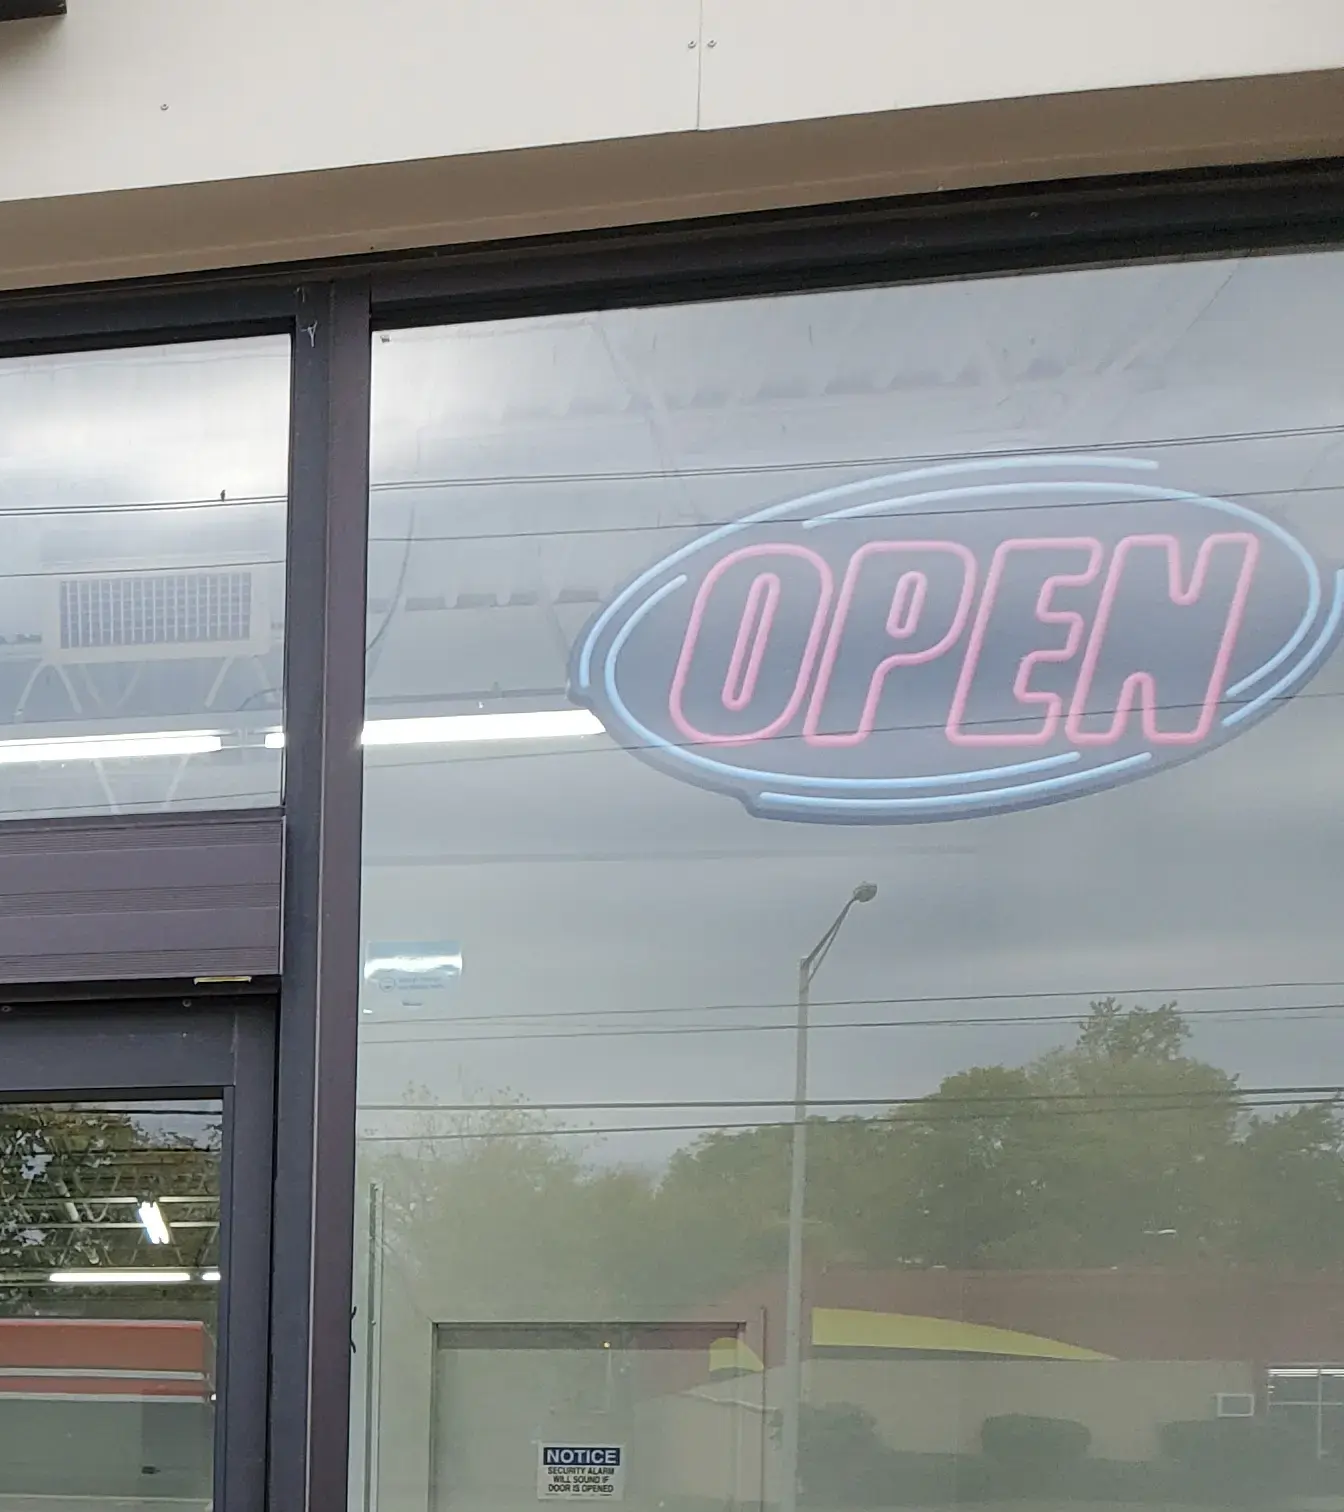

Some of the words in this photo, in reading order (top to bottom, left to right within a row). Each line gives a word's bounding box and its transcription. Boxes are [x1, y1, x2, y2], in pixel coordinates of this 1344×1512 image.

[667, 531, 1261, 749] OPEN
[546, 1449, 617, 1464] NOTICE
[548, 1467, 587, 1475] SECURITY
[588, 1467, 615, 1475] ALARM
[553, 1475, 571, 1483] WILL
[573, 1475, 600, 1484] SOUND
[602, 1475, 610, 1484] IF
[548, 1484, 571, 1492] DOOR
[573, 1484, 580, 1492] IS
[581, 1484, 614, 1493] OPENED
